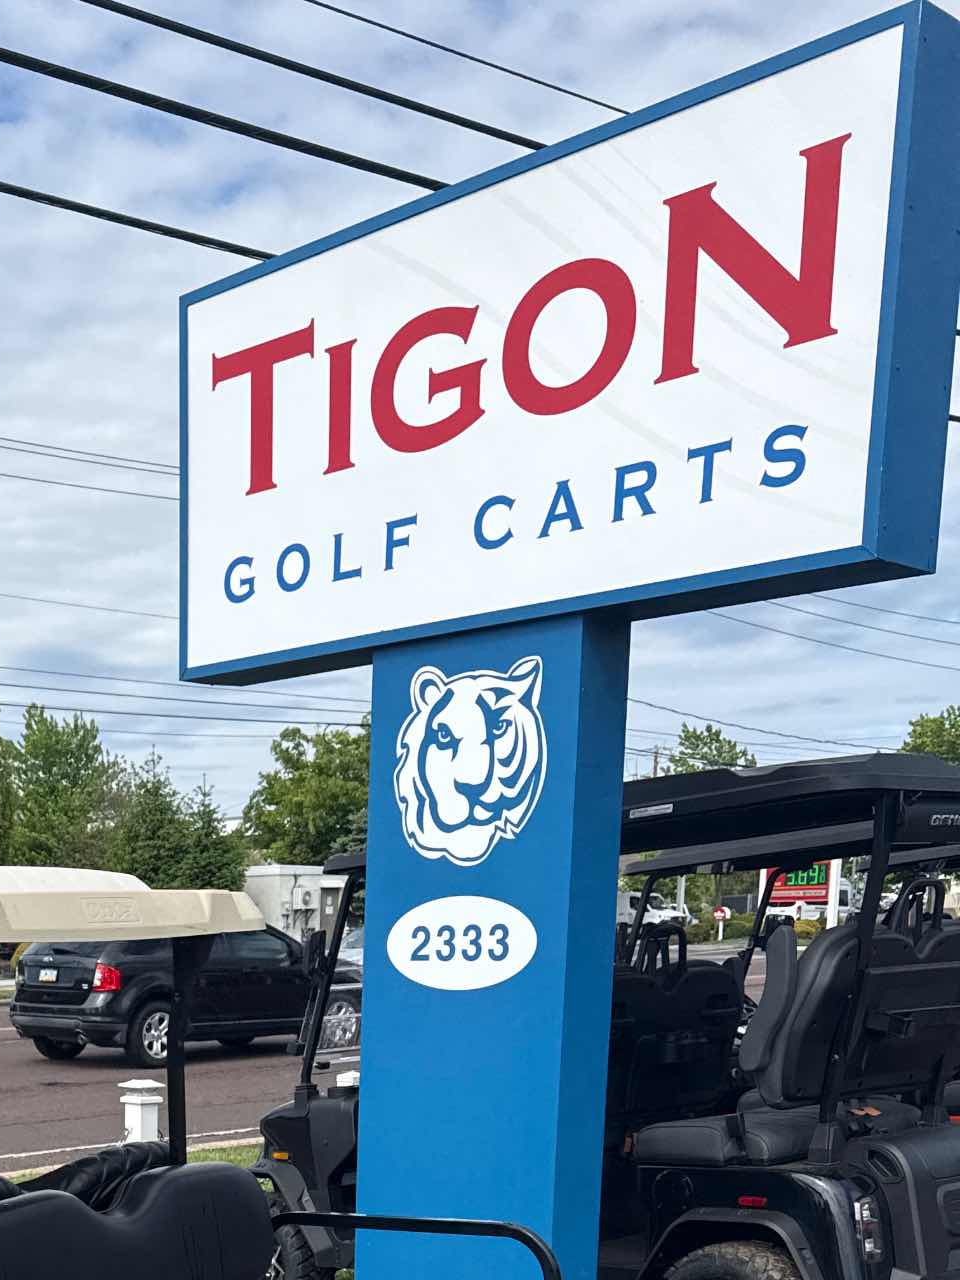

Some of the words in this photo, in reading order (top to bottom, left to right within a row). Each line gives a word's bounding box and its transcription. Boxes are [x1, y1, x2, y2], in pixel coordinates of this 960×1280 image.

[212, 132, 852, 496] TIGON
[224, 514, 418, 604] GOLF
[473, 425, 809, 550] CARTS
[410, 923, 510, 962] 2333
